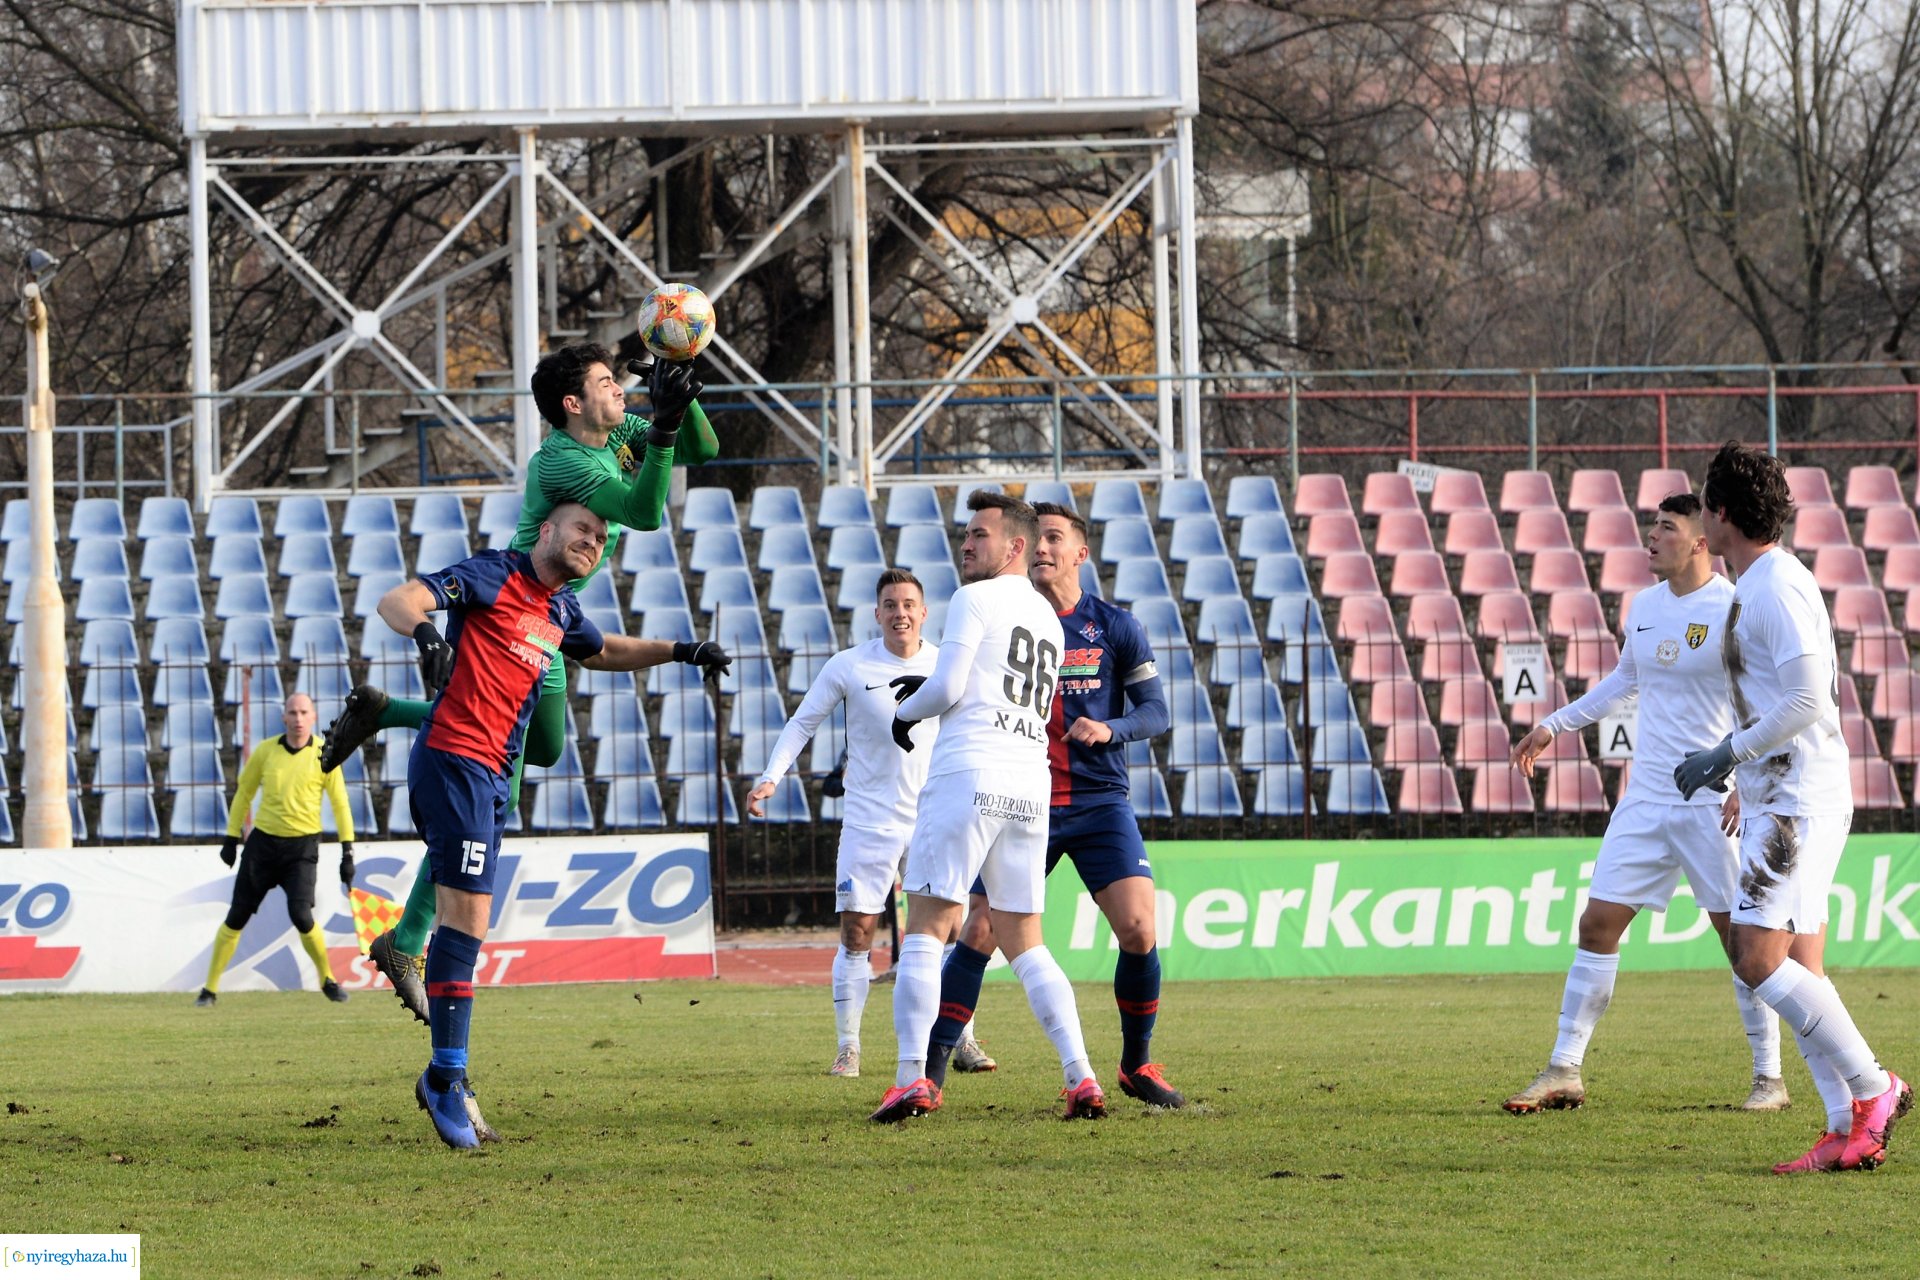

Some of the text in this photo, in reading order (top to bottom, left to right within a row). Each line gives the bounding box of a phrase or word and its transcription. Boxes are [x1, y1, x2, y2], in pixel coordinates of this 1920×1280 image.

[1003, 625, 1057, 721] 96
[1514, 668, 1537, 696] A
[1610, 724, 1633, 751] A
[973, 791, 1044, 817] PRO-TERMINAL
[461, 840, 487, 875] 15
